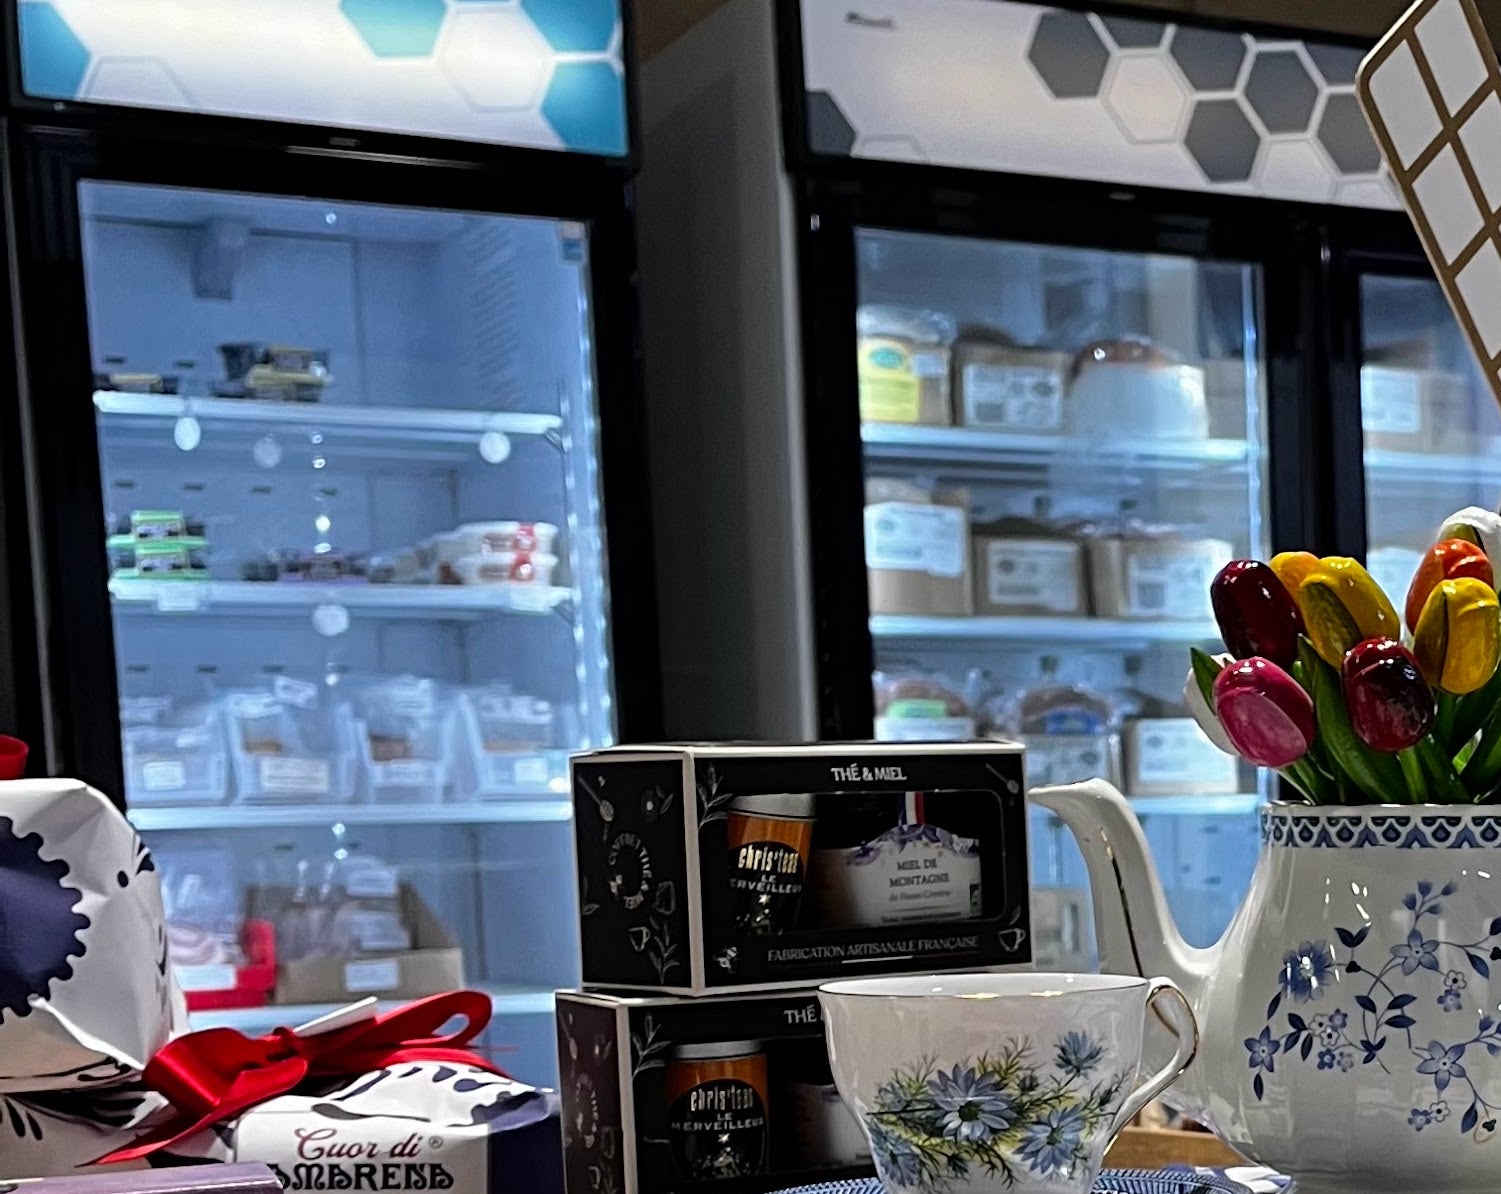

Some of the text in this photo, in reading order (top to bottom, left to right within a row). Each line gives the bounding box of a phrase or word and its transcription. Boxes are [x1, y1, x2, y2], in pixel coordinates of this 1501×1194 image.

[831, 763, 907, 781] THÉ & MIEL
[897, 858, 937, 871] MIEL DE
[761, 874, 776, 884] LE
[889, 873, 951, 888] MONTAGNE
[767, 945, 846, 962] FABRICATION
[846, 941, 917, 957] ARTISANALE
[784, 1004, 818, 1024] THÉ
[717, 1112, 733, 1121] LE
[294, 1127, 424, 1161] Cuor di
